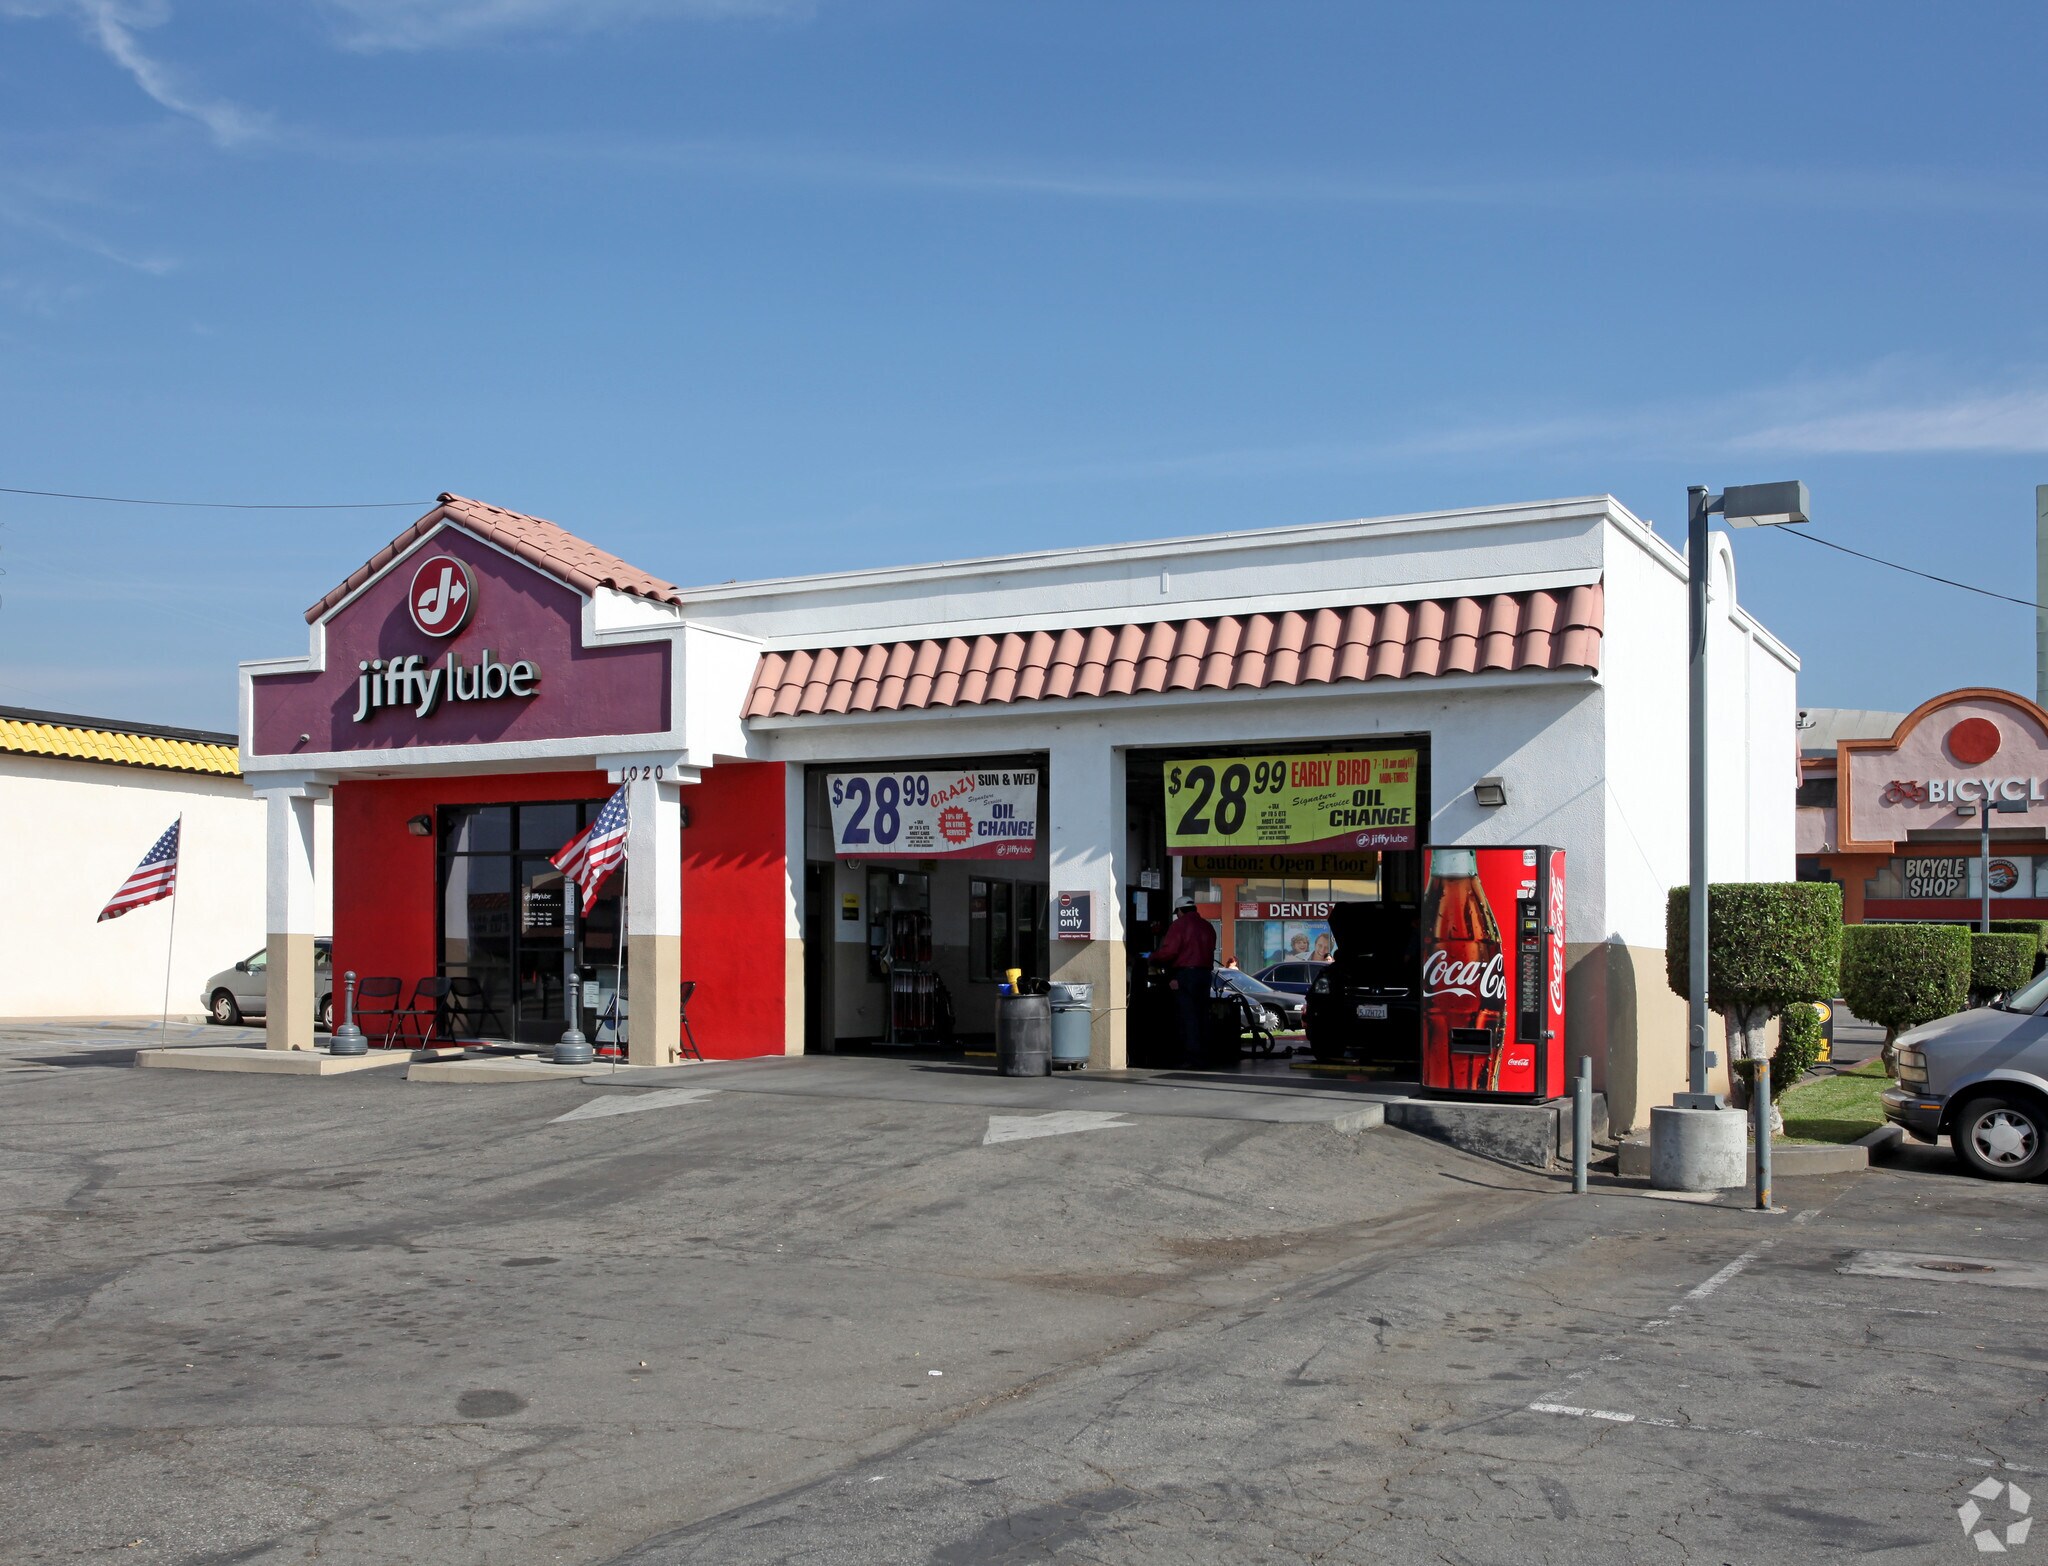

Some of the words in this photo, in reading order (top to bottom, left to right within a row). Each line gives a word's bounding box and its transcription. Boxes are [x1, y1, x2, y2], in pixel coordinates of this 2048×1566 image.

[621, 764, 663, 782] 1020
[978, 773, 999, 786] SUN
[1002, 773, 1010, 785] &
[1012, 772, 1035, 786] WED
[1291, 760, 1332, 787] EARLY
[1337, 759, 1370, 786] BIRD
[930, 773, 975, 808] CRAZY
[1292, 791, 1336, 807] Signature
[1352, 788, 1384, 807] OIL
[992, 803, 1015, 819] OIL
[1317, 799, 1350, 811] Service
[1329, 807, 1411, 827] CHANGE
[977, 820, 1034, 837] CHANGE
[1193, 854, 1264, 872] Caution:
[1269, 854, 1315, 875] Open
[1321, 854, 1368, 873] Floor
[1905, 858, 1965, 880] BICYCLE
[1909, 878, 1959, 897] SHOP
[1060, 906, 1079, 917] exit
[1060, 916, 1082, 929] only
